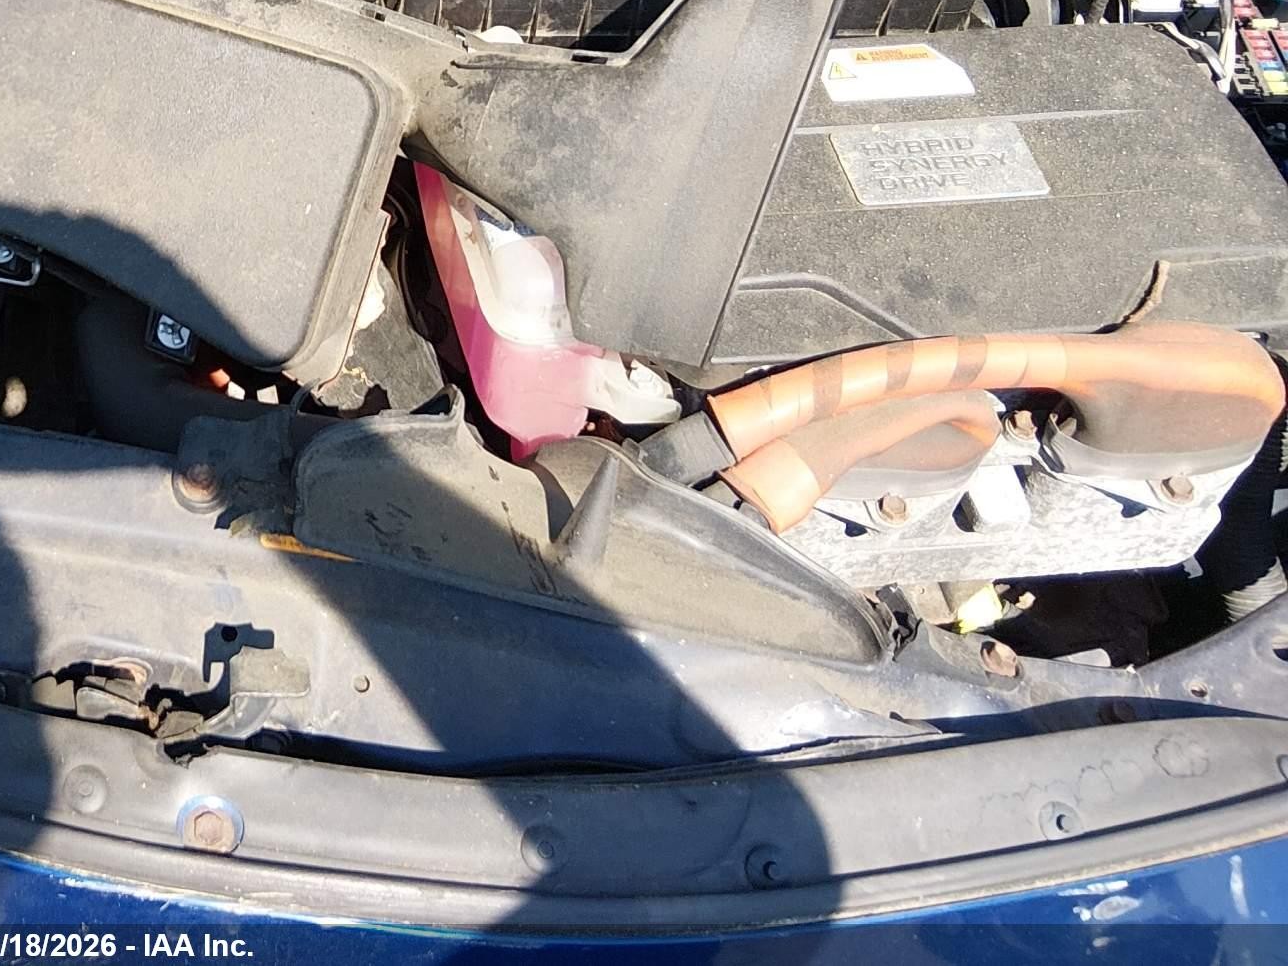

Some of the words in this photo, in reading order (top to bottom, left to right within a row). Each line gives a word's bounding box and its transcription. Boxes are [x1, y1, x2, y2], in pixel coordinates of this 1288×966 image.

[860, 137, 974, 156] HYBRID
[869, 152, 1009, 172] SYNERGY
[877, 172, 971, 191] DRIVE
